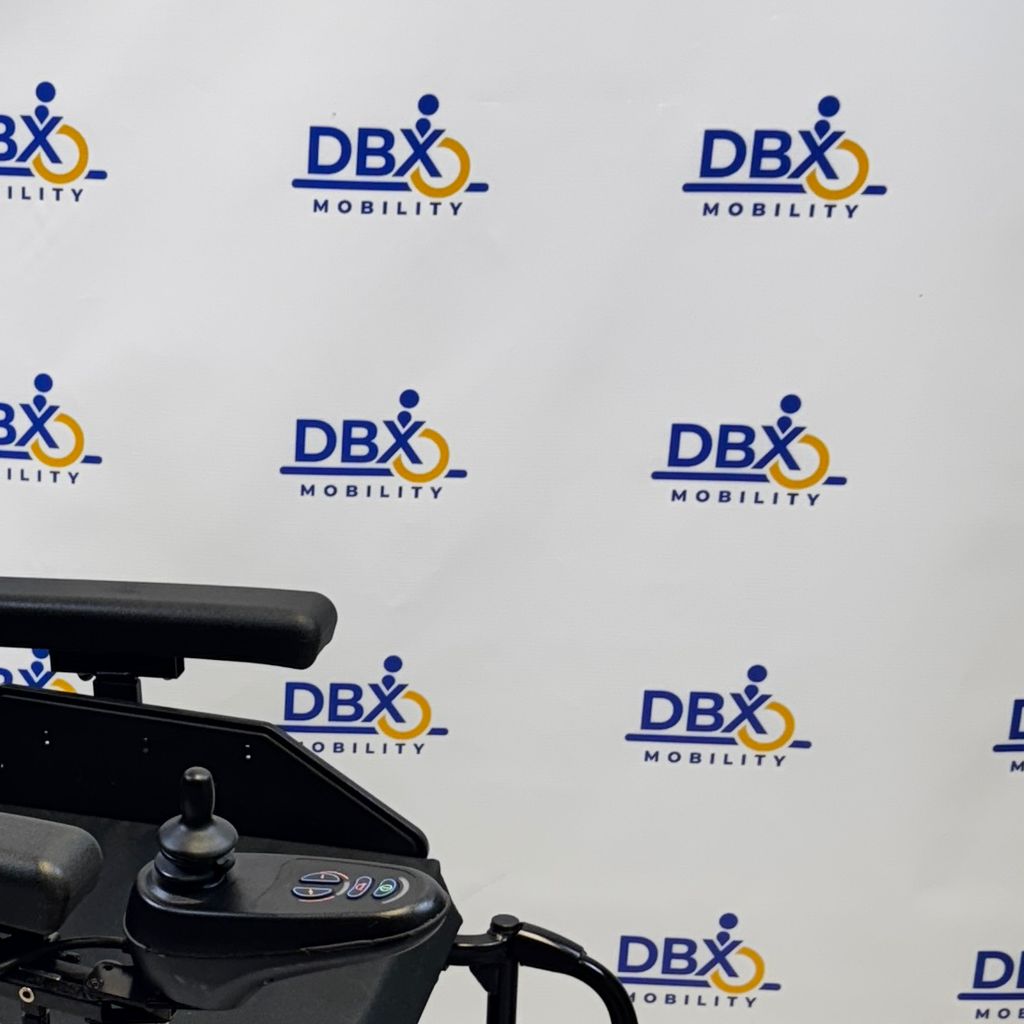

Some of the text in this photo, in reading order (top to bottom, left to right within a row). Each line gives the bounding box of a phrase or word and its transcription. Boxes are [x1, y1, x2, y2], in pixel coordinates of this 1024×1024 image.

[307, 126, 445, 178] DBX
[699, 129, 845, 180] DBX
[313, 199, 463, 216] MOBILITY
[703, 202, 859, 219] MOBILITY
[295, 419, 426, 464] DBX
[667, 423, 806, 471] DBX
[300, 484, 442, 499] MOBILITY
[671, 489, 820, 506] MOBILITY
[284, 682, 408, 723] DBX
[640, 690, 772, 734] DBX
[302, 740, 427, 755] OBILITY
[644, 750, 786, 767] MOBILITY
[618, 935, 743, 978] DBX
